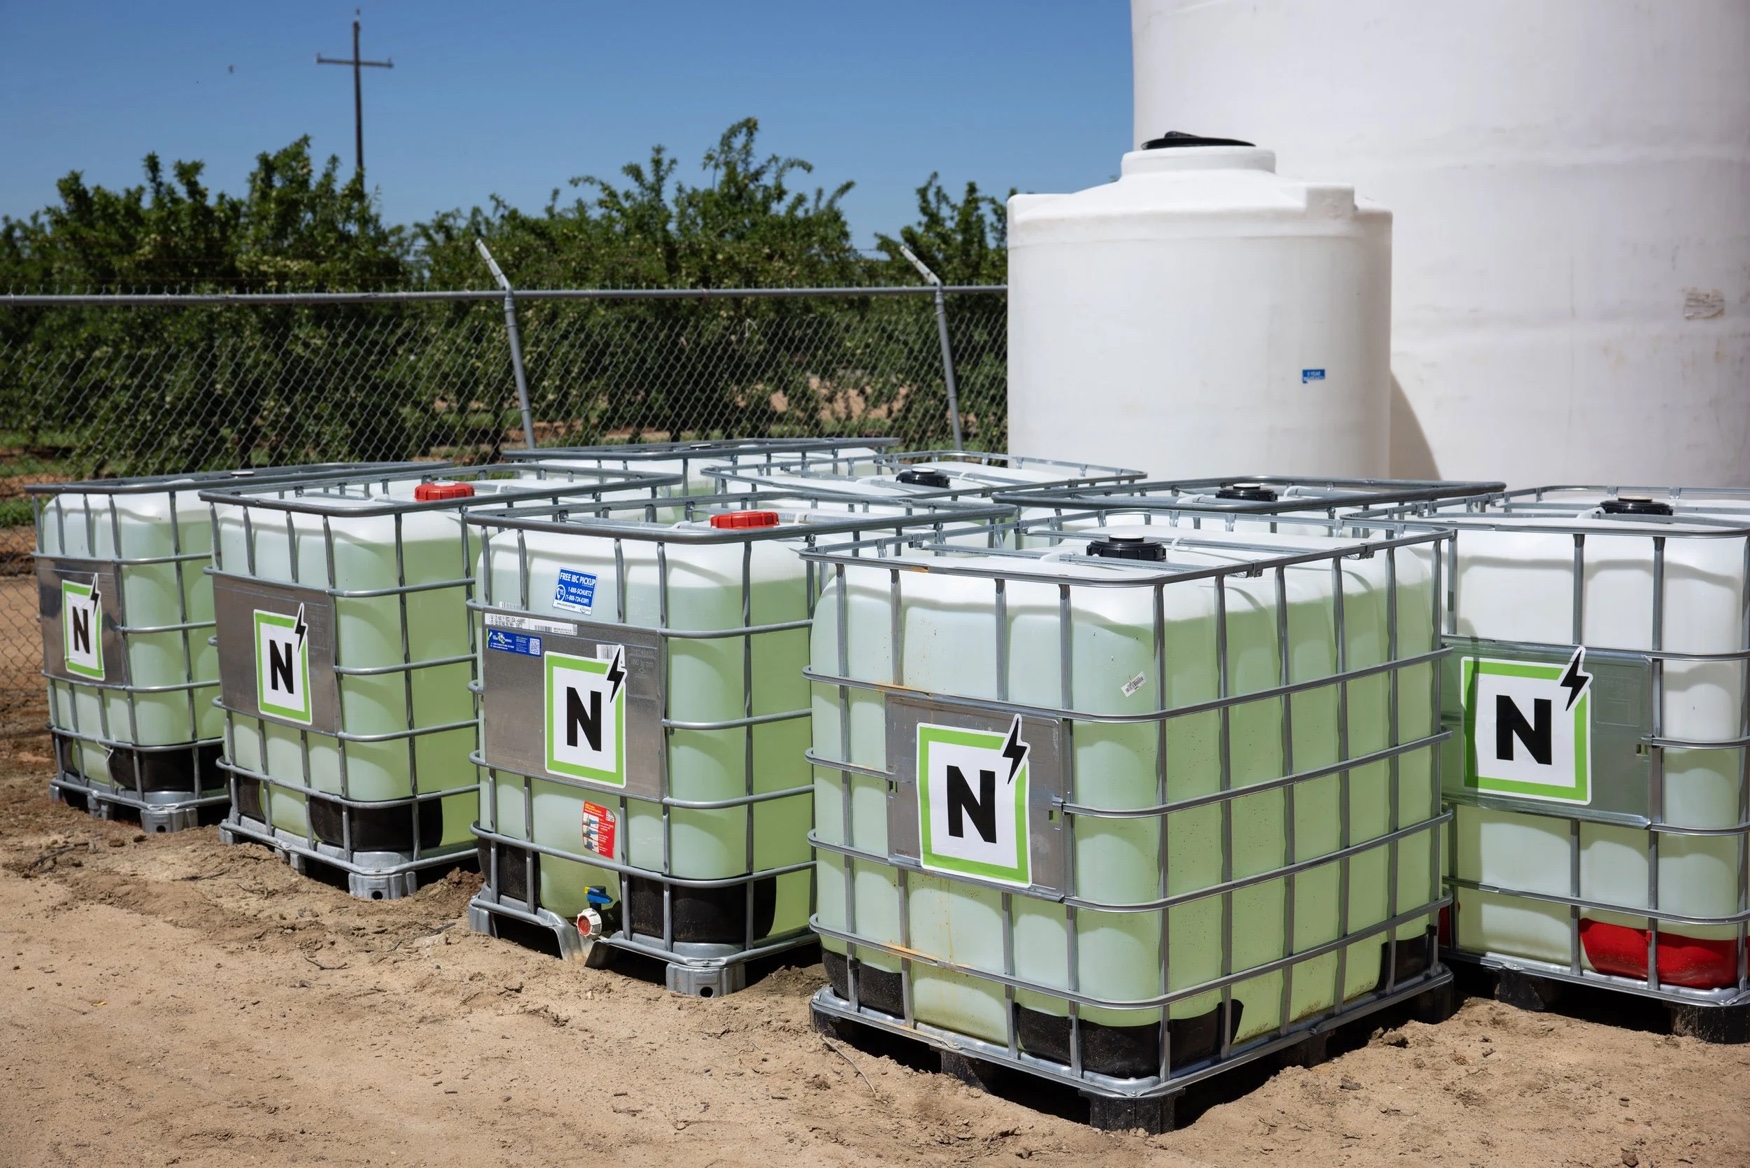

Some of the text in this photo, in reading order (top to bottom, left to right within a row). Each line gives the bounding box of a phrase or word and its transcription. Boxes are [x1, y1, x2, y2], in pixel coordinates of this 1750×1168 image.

[560, 572, 596, 587] FREE IBC PICKUP
[73, 606, 90, 654] N
[270, 640, 294, 695] N
[567, 686, 602, 752] N
[1496, 694, 1552, 766] N
[946, 765, 997, 844] N
